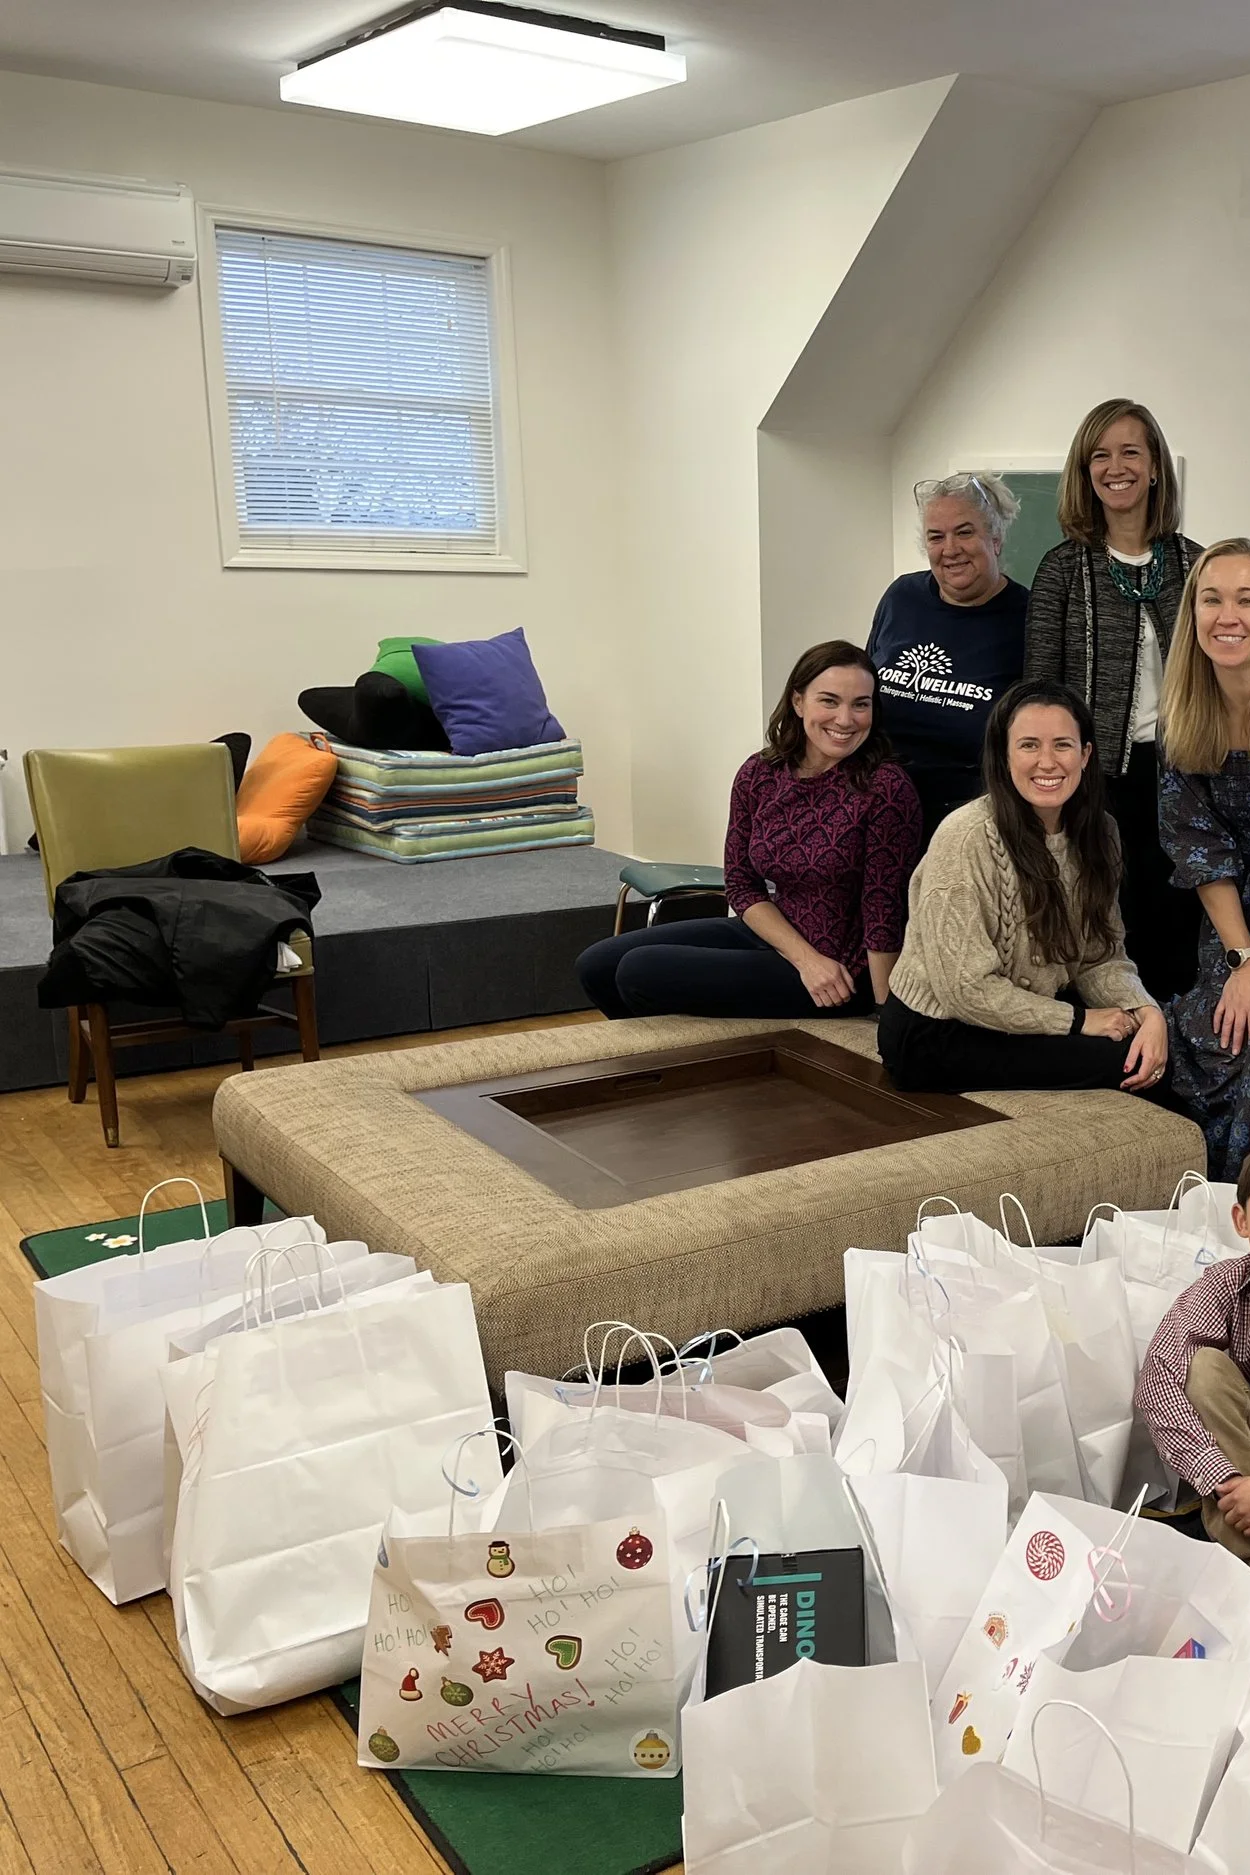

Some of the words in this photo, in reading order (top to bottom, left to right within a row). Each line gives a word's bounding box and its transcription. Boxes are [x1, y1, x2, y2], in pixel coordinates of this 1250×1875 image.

[880, 684, 915, 700] Chiropractic
[920, 694, 942, 706] Holistic
[946, 698, 974, 711] Massage
[920, 676, 993, 702] WELLNESS
[528, 1564, 576, 1604] HO!
[768, 1594, 776, 1604] BE
[780, 1594, 788, 1608] THE
[527, 1600, 576, 1636] HO!
[580, 1576, 622, 1610] HO!
[756, 1595, 765, 1634] SIMULATED
[768, 1606, 776, 1634] OPENED,
[780, 1608, 788, 1628] CAGE
[796, 1590, 816, 1658] DINO
[374, 1628, 402, 1652] HO!
[406, 1628, 428, 1647] HO!
[604, 1627, 641, 1673] HO!
[780, 1628, 788, 1643] CAN
[604, 1671, 638, 1706] HO!
[635, 1639, 664, 1673] HO!
[755, 1634, 764, 1682] TRANSPORTA
[426, 1682, 536, 1744] MERRY
[435, 1678, 591, 1768] CHRISTMAS!
[521, 1727, 552, 1758] HO!
[529, 1748, 560, 1774] HO!
[559, 1724, 590, 1752] HO!
